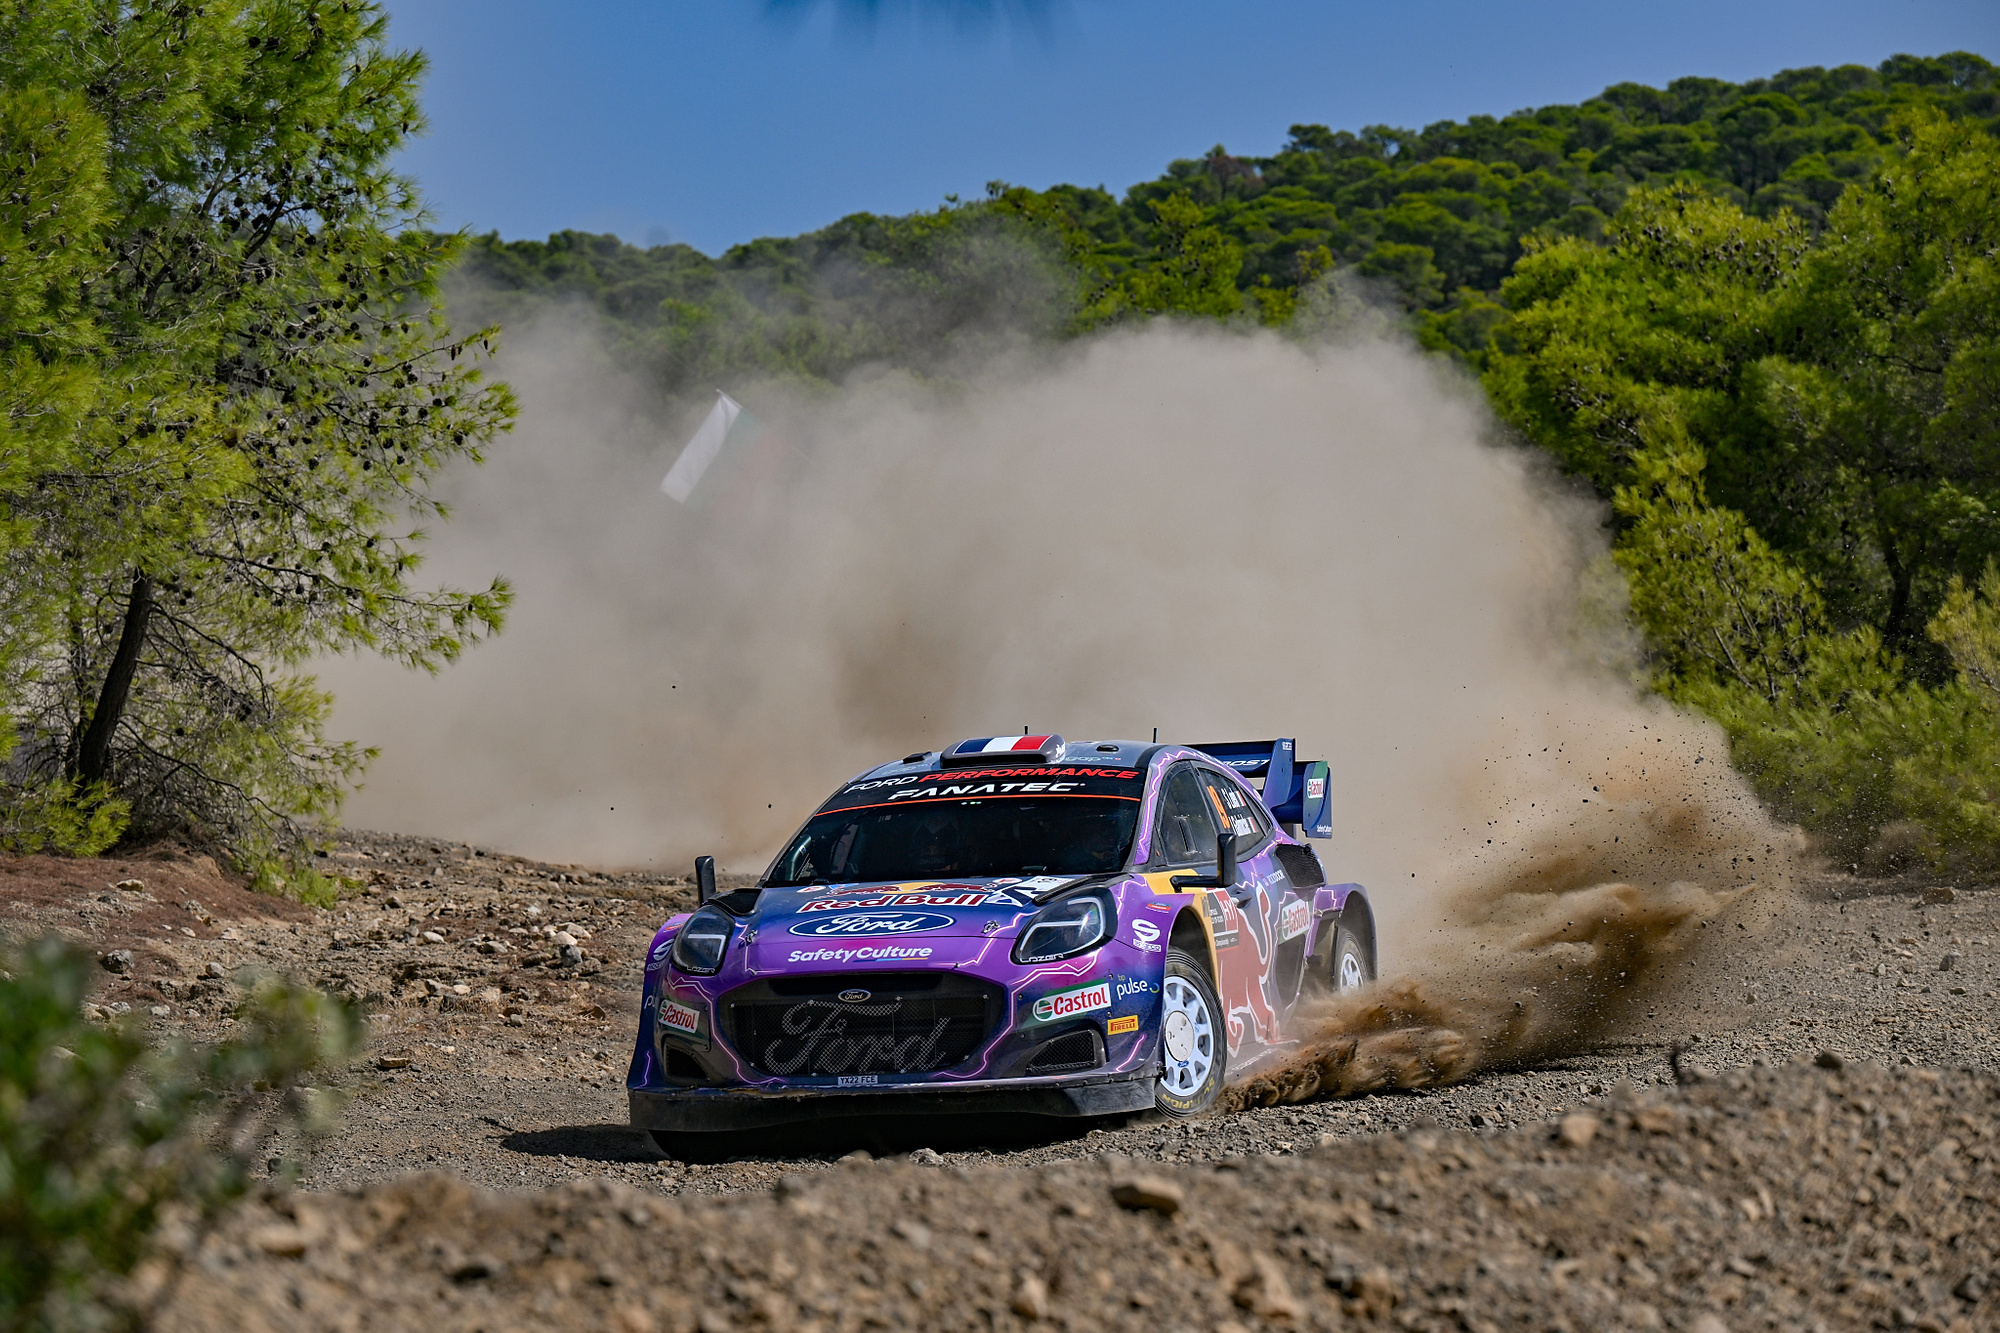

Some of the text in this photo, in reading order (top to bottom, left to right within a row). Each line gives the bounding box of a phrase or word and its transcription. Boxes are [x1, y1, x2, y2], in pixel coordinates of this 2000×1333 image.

[843, 776, 918, 794] FORD
[918, 768, 1140, 783] PERFORMANCE
[888, 783, 1079, 800] FANATEC
[796, 894, 989, 913] Red Bull
[815, 914, 927, 933] Ford
[1288, 903, 1309, 934] Castrol
[788, 946, 933, 963] SafetyCulture
[1117, 974, 1126, 982] bp
[845, 991, 864, 1000] Ford
[1116, 977, 1148, 1000] pulse
[1054, 987, 1108, 1015] Castrol
[663, 1004, 697, 1030] Castrol
[1110, 1018, 1136, 1032] PIRELLI
[764, 1001, 951, 1075] Ford
[840, 1075, 876, 1084] YX22 FCE
